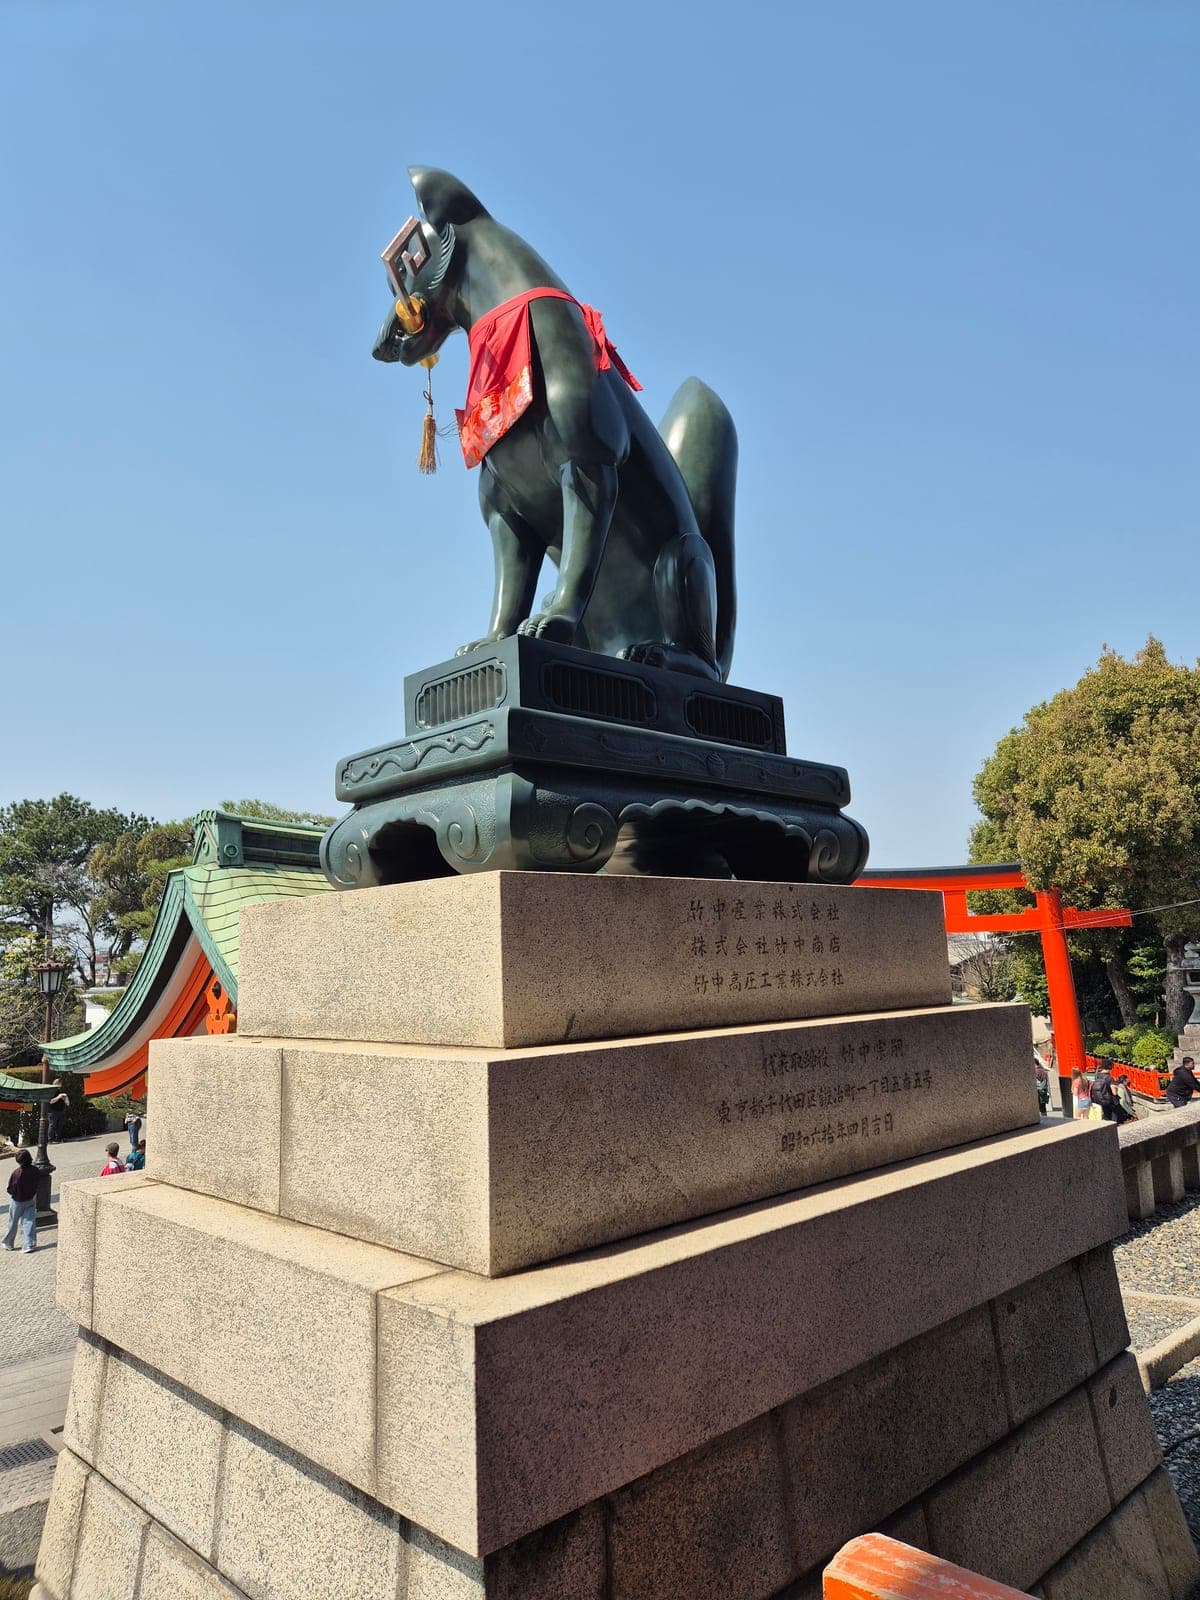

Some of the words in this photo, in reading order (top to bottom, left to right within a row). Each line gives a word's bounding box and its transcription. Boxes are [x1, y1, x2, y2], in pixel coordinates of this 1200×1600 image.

[691, 933, 841, 957] 株式会社竹中商店
